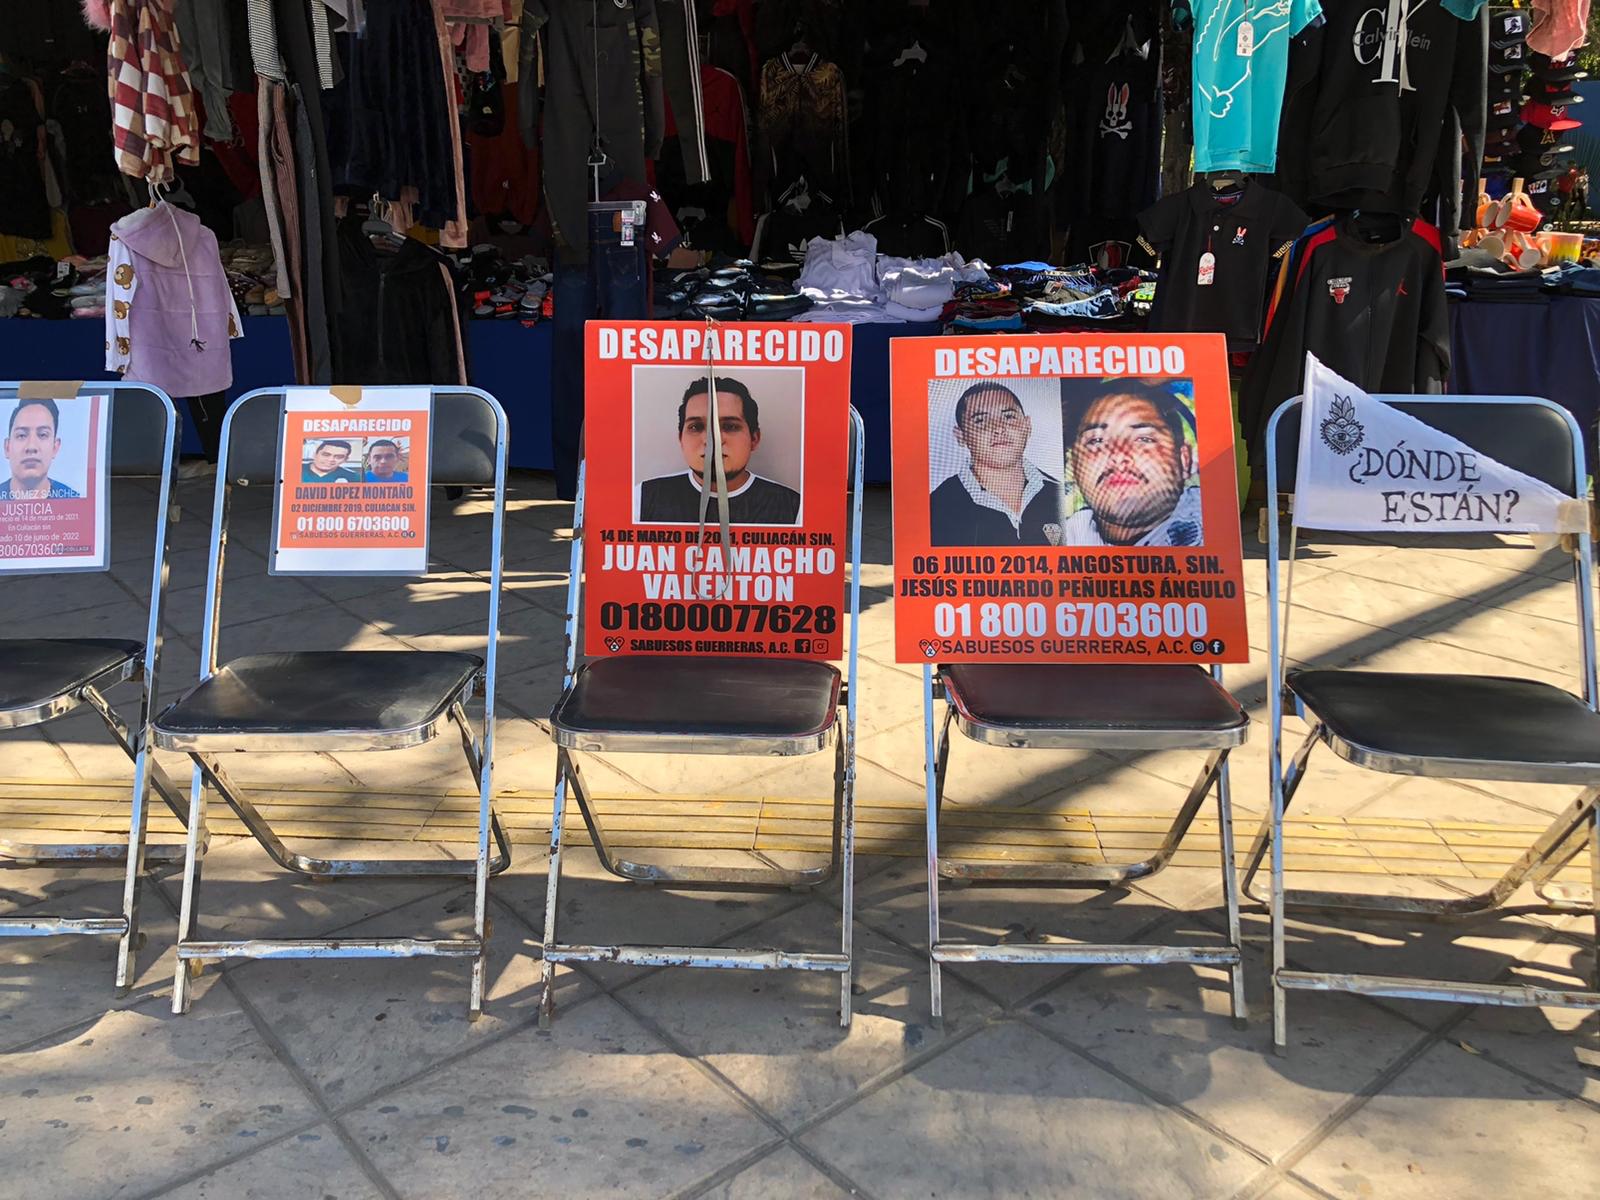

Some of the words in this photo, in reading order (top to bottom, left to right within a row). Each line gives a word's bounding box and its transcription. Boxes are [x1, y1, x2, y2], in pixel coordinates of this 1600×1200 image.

[599, 328, 843, 362] DESAPARECIDO
[935, 346, 1185, 376] DESAPARECIDO
[303, 418, 412, 432] DESAPARECIDO
[1349, 440, 1481, 484] ¿DÓNDE
[295, 487, 327, 500] DAVID
[330, 487, 360, 499] LOPEZ
[362, 484, 413, 499] MONTAÑO
[2, 503, 53, 516] JUSTICIA
[291, 504, 301, 512] 02
[302, 504, 342, 512] DICIEMBRE
[402, 503, 417, 512] SIN.
[1381, 484, 1520, 523] ESTÁN?
[297, 516, 313, 531] 01
[316, 516, 344, 531] 800
[347, 515, 410, 531] 6703600
[23, 533, 33, 541] de
[50, 532, 60, 540] de
[63, 531, 80, 541] 2022
[600, 529, 615, 542] 14
[618, 529, 634, 542] DE
[637, 530, 682, 543] MARZO
[703, 531, 739, 546] 201,
[742, 530, 807, 545] CULIACÁN
[809, 532, 836, 546] SIN.
[602, 544, 676, 571] JUAN
[684, 545, 836, 575] CAMACHO
[912, 556, 939, 574] 06
[943, 556, 995, 574] JULIO
[1000, 555, 1053, 575] 2014,
[1057, 555, 1181, 575] ANGOSTURA,
[1185, 555, 1224, 574] SIN.
[642, 573, 794, 602] VALENTON
[901, 576, 957, 597] JESÚS
[963, 579, 1053, 597] EDUARDO
[1059, 576, 1155, 598] PEÑUELAS
[1159, 577, 1236, 598] ÁNGULO
[600, 601, 837, 635] 01800077628
[934, 602, 972, 637] 01
[980, 602, 1047, 637] 800
[1055, 602, 1208, 637] 6703600
[630, 639, 693, 652] SABUESOS
[695, 640, 767, 654] GUERRERAS,
[768, 641, 791, 654] A.C.
[942, 640, 1035, 654] SABUESOS
[1041, 639, 1151, 656] GUERRERAS,
[1156, 640, 1188, 654] A.C.
